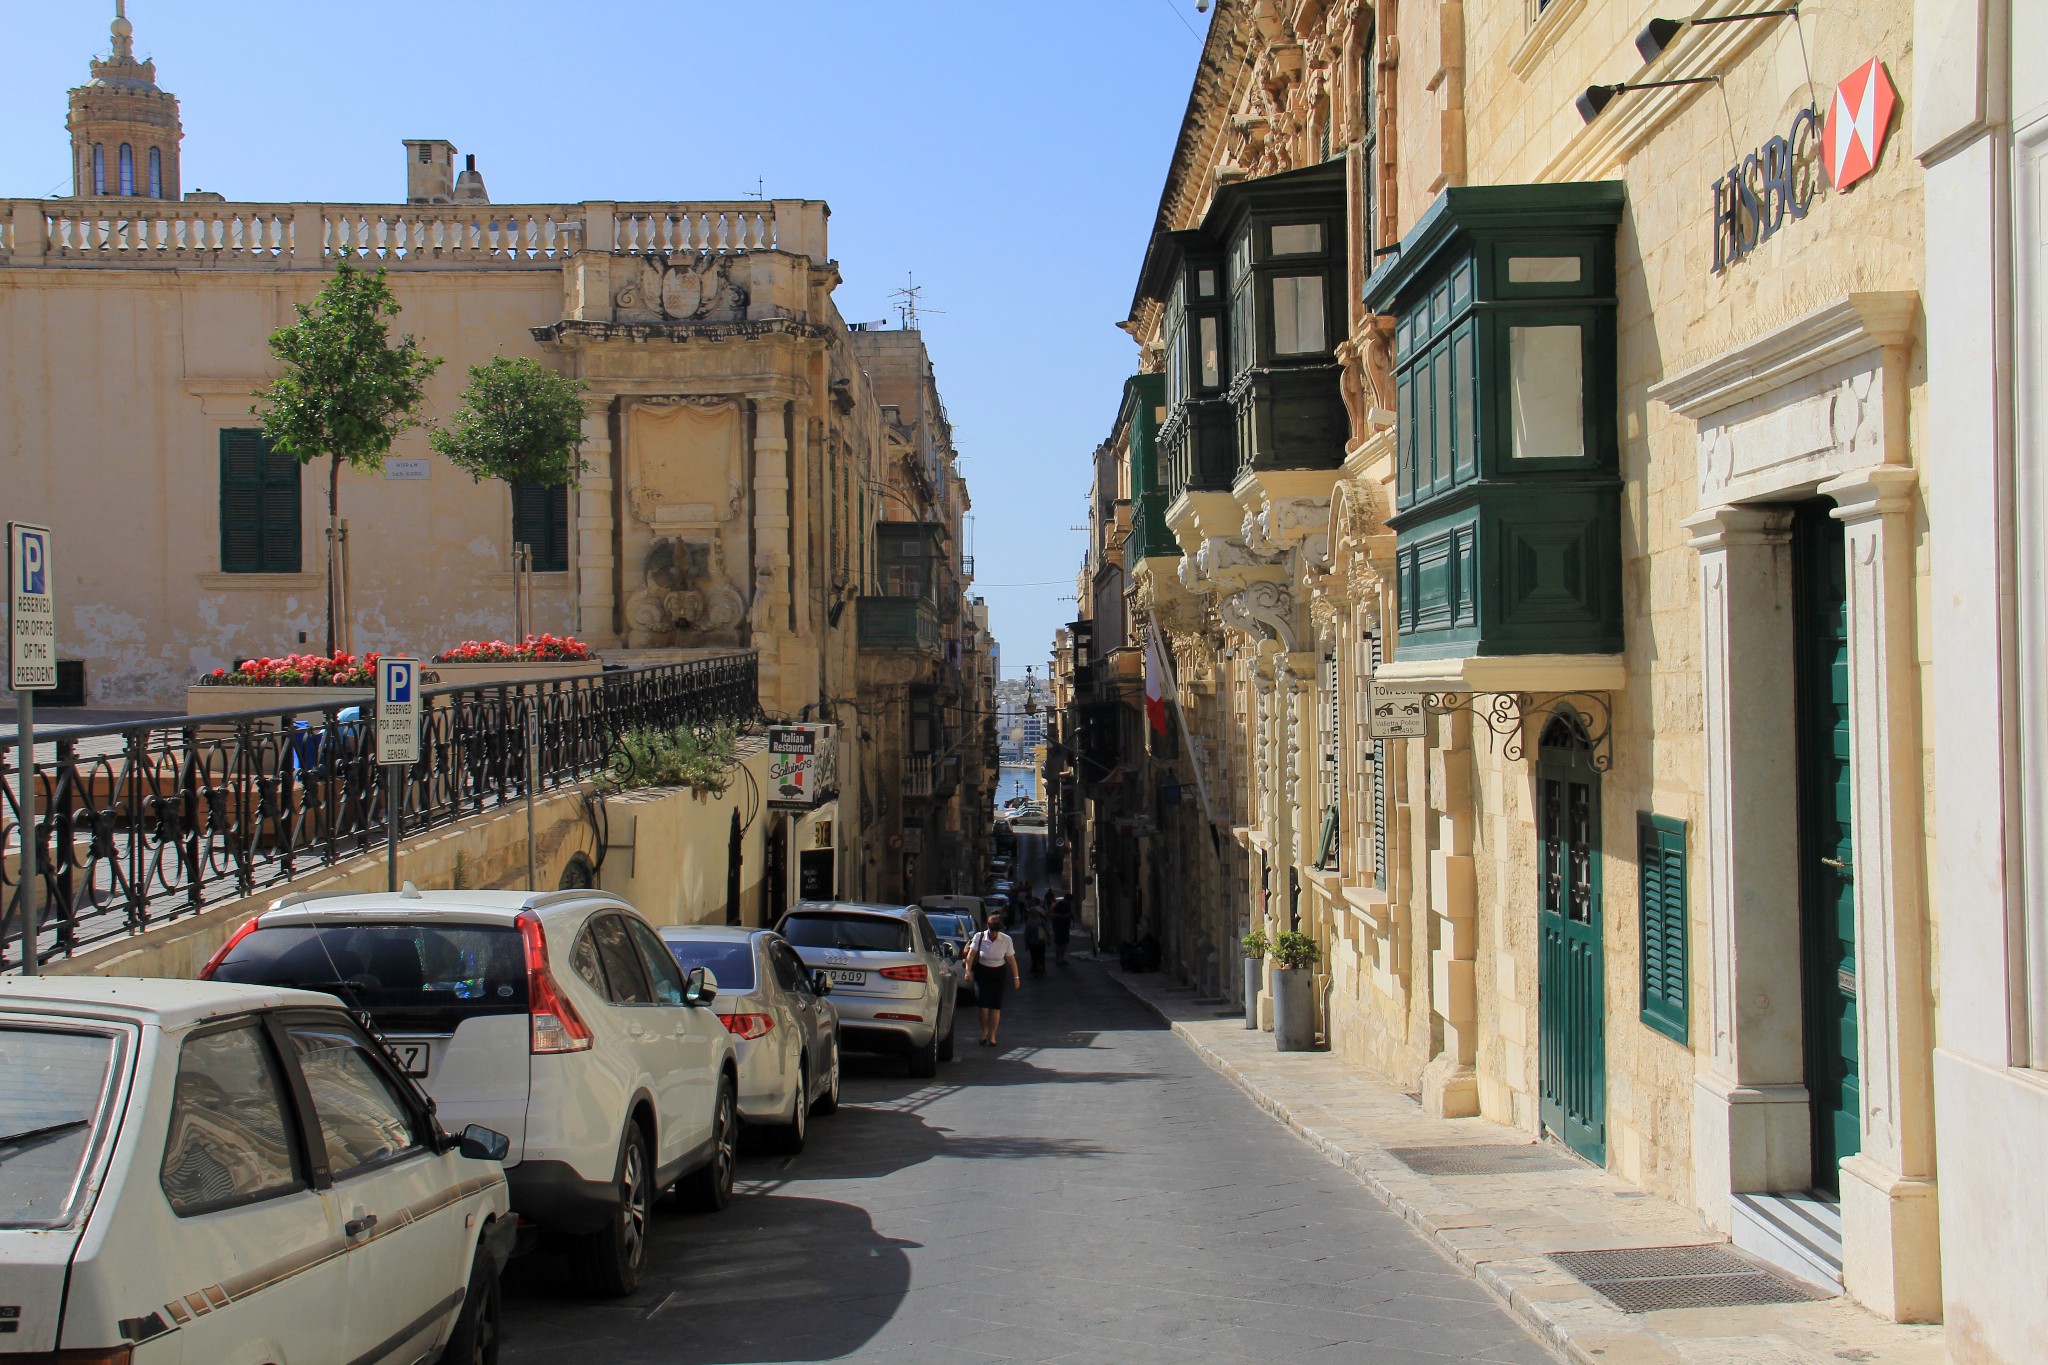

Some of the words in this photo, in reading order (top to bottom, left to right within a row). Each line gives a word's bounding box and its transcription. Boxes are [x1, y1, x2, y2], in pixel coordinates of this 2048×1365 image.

[1709, 101, 1816, 275] HSBC
[25, 537, 42, 591] P
[18, 596, 51, 614] RESERVED
[16, 620, 30, 636] FOR
[31, 620, 53, 637] OFFICE
[24, 643, 33, 659] OF
[34, 643, 47, 659] THE
[17, 666, 54, 683] PRESIDENT
[391, 665, 408, 701] P
[385, 704, 412, 715] RESERVED
[379, 719, 390, 730] FOR
[392, 719, 412, 730] DEPUTY
[385, 734, 412, 745] ATTORNEY
[781, 732, 805, 744] Italian
[387, 749, 411, 760] GENERAL
[773, 742, 812, 753] Restaurant
[841, 971, 863, 982] 609
